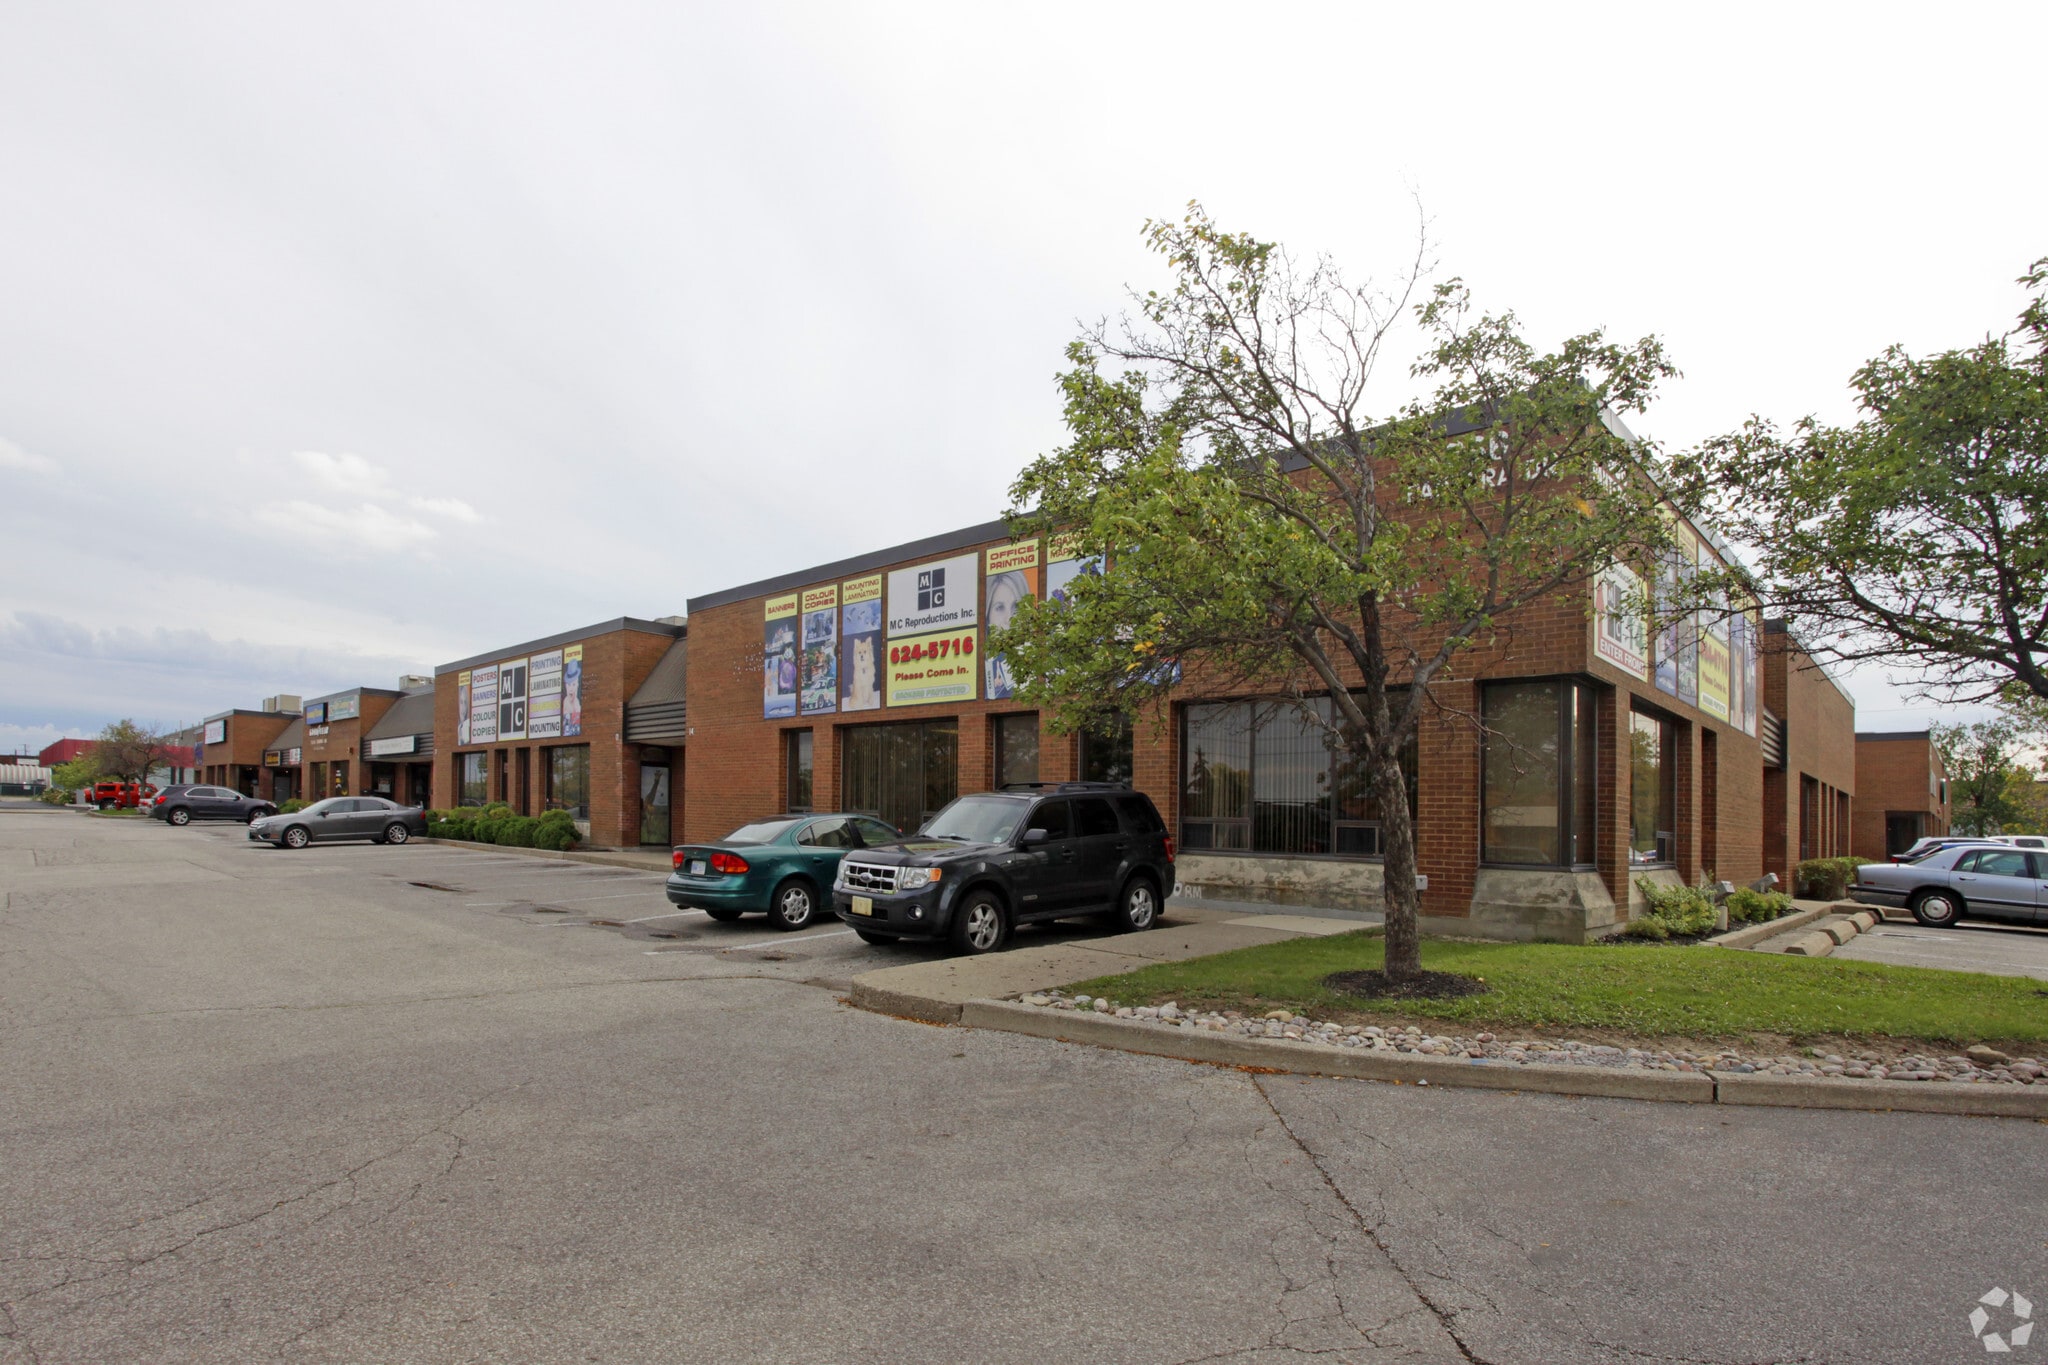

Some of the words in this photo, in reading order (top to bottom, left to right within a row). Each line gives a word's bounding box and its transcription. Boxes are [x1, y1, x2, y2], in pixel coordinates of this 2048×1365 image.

[989, 545, 1035, 561] OFFICE
[989, 554, 1035, 571] PRINTING
[845, 579, 879, 591] MOUNTING
[919, 574, 930, 588] M
[805, 589, 835, 602] COLOUR
[844, 588, 879, 601] LAMINATING
[933, 592, 943, 604] C
[767, 602, 795, 615] BANNERS
[804, 597, 835, 610] COPIES
[905, 611, 958, 629] Reproductions
[960, 607, 976, 619] Inc.
[890, 636, 974, 664] 624-5716
[1600, 641, 1623, 661] ENTER
[531, 655, 561, 671] PRINTING
[473, 670, 497, 683] POSTERS
[895, 672, 924, 682] Please
[926, 668, 954, 678] Come
[957, 665, 969, 675] In.
[502, 676, 511, 694] M
[530, 677, 561, 691] LAMINATING
[472, 689, 496, 702] BANNERS
[472, 711, 496, 722] COLOUR
[515, 708, 523, 726] C
[472, 726, 496, 737] COPIES
[530, 722, 560, 733] MOUNTING
